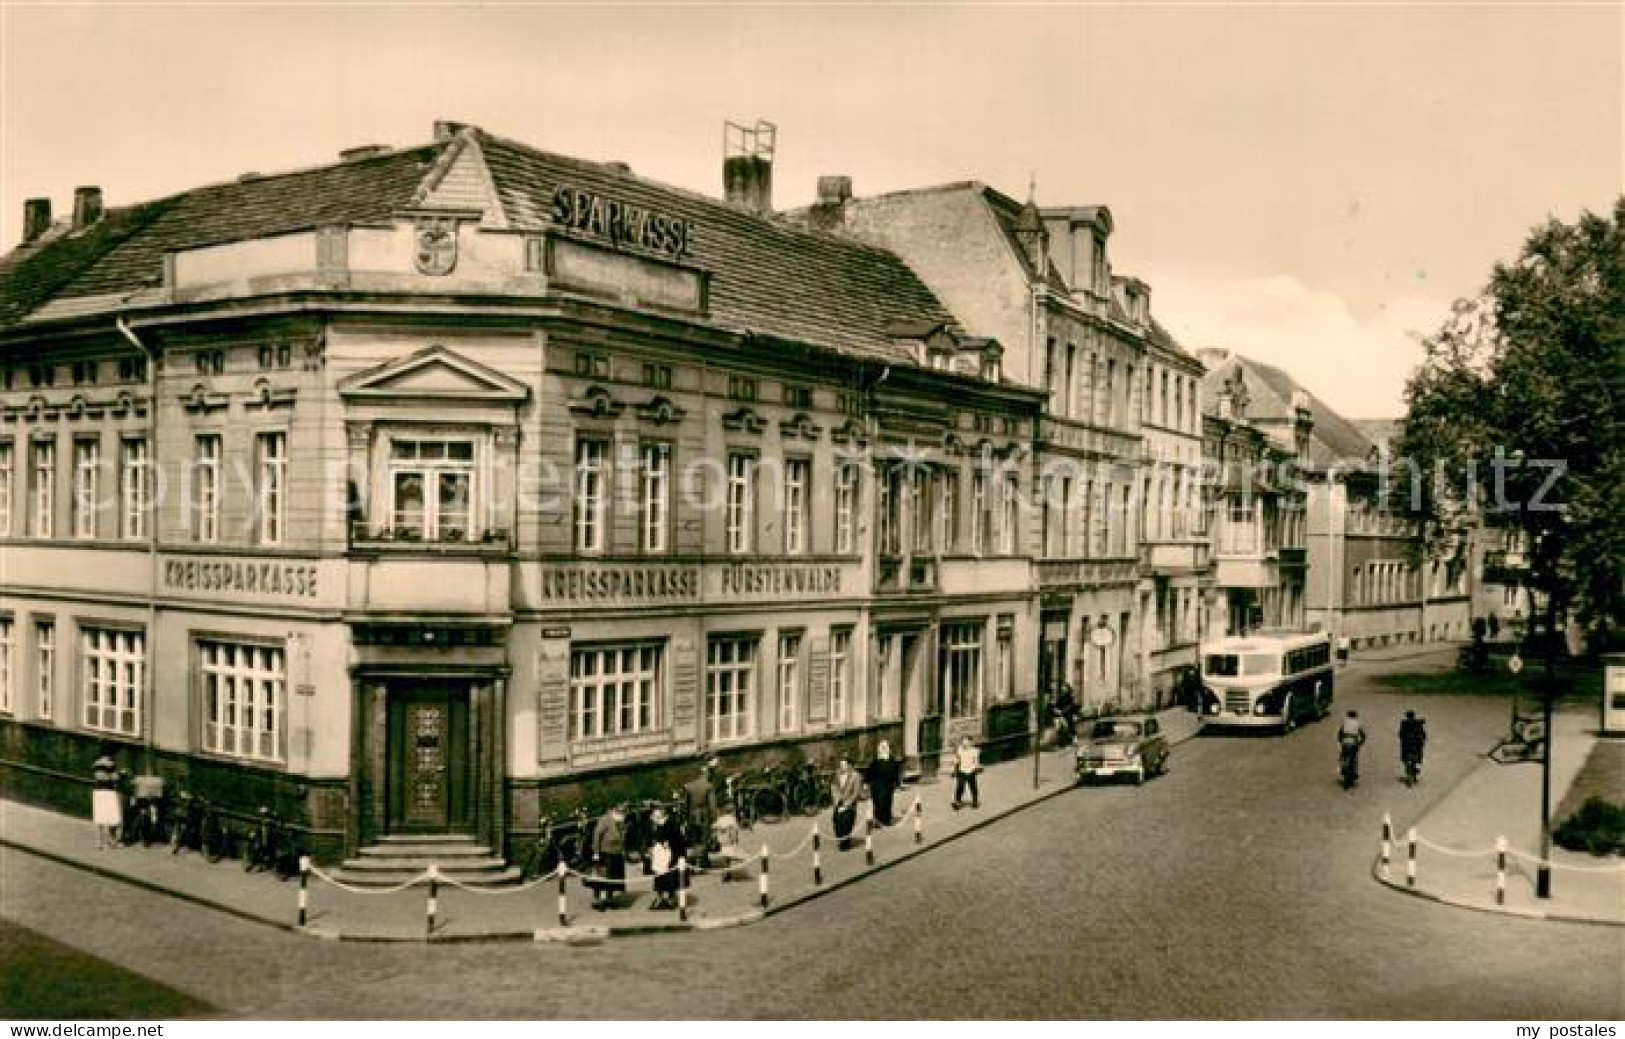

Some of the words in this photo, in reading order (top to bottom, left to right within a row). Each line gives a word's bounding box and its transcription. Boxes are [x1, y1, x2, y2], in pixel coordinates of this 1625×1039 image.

[552, 186, 695, 257] SPARKASSE
[165, 560, 317, 597] KREISSPARKASSE
[541, 568, 698, 599] KREISSPARKASSE
[720, 564, 841, 595] FÜRSTENWALDE
